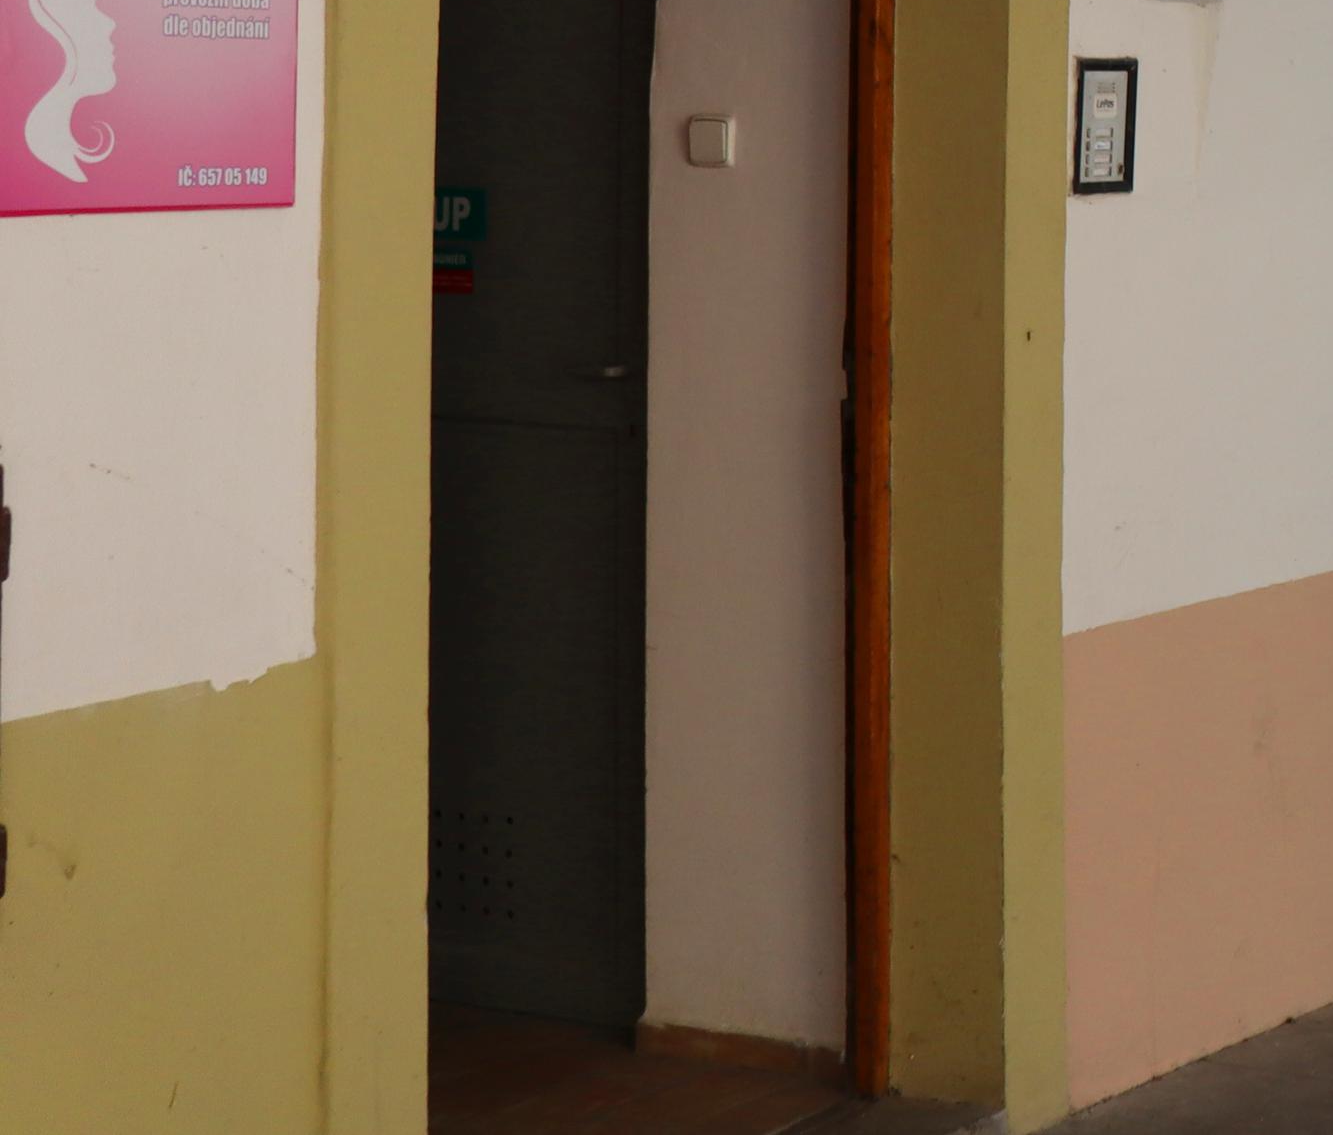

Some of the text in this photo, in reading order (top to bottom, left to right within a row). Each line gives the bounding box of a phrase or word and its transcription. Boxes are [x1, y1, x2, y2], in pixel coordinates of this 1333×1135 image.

[163, 14, 270, 40] dle objednání
[178, 164, 268, 187] IČ: 657 05 149
